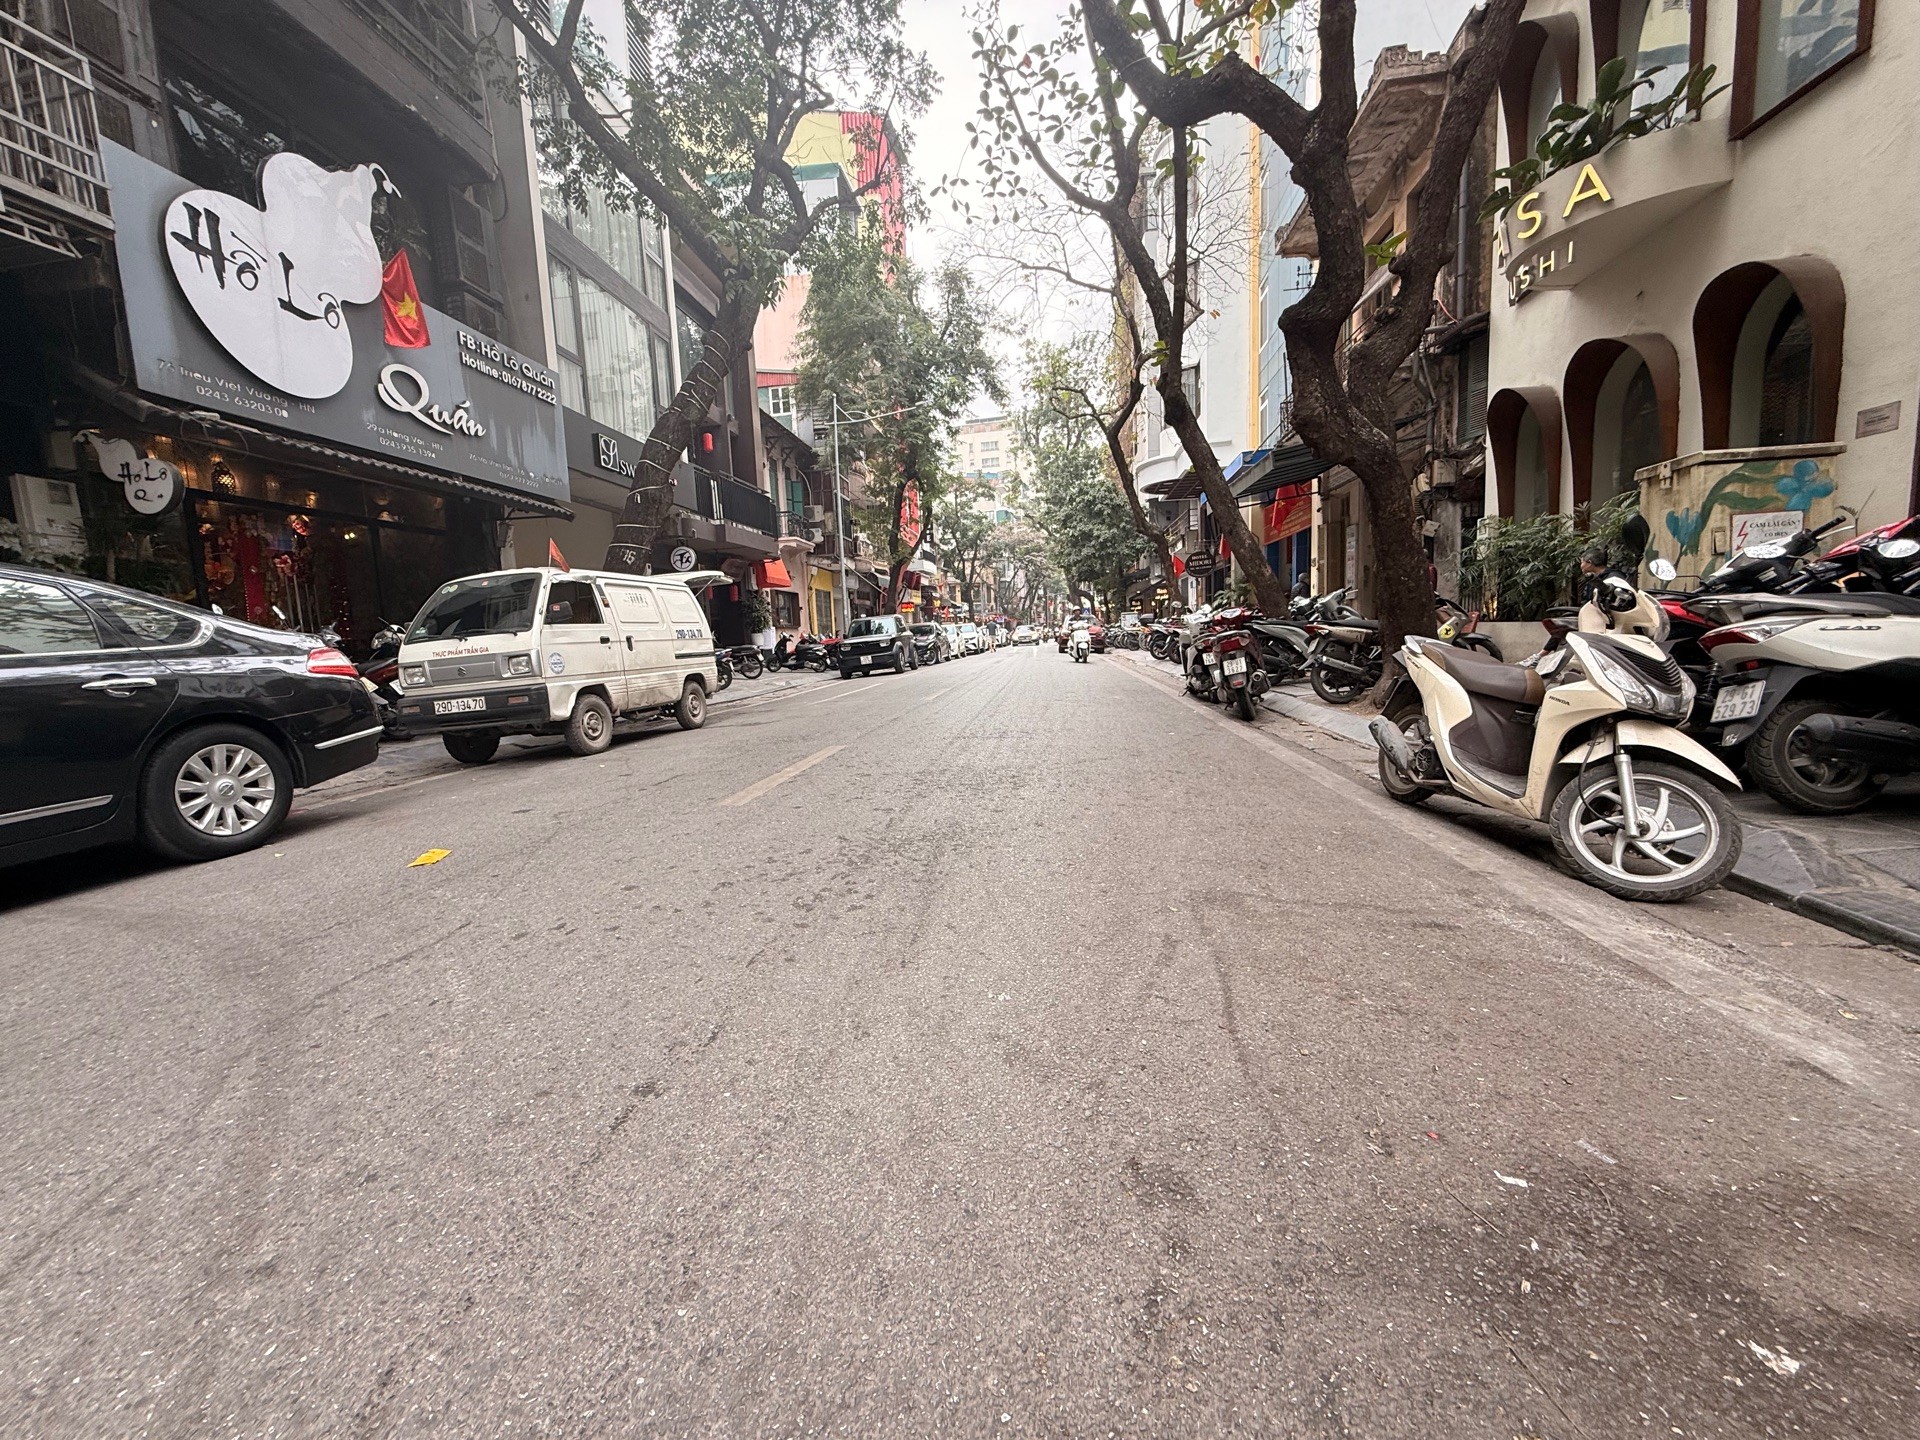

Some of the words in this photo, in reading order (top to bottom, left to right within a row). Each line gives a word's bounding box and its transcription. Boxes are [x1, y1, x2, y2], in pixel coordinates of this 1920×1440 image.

[276, 251, 340, 329] Lô
[522, 363, 556, 389] Quán
[299, 403, 315, 414] HN
[378, 362, 487, 438] Quán
[436, 698, 484, 713] 29D-134.70
[1714, 700, 1756, 720] 529.73
